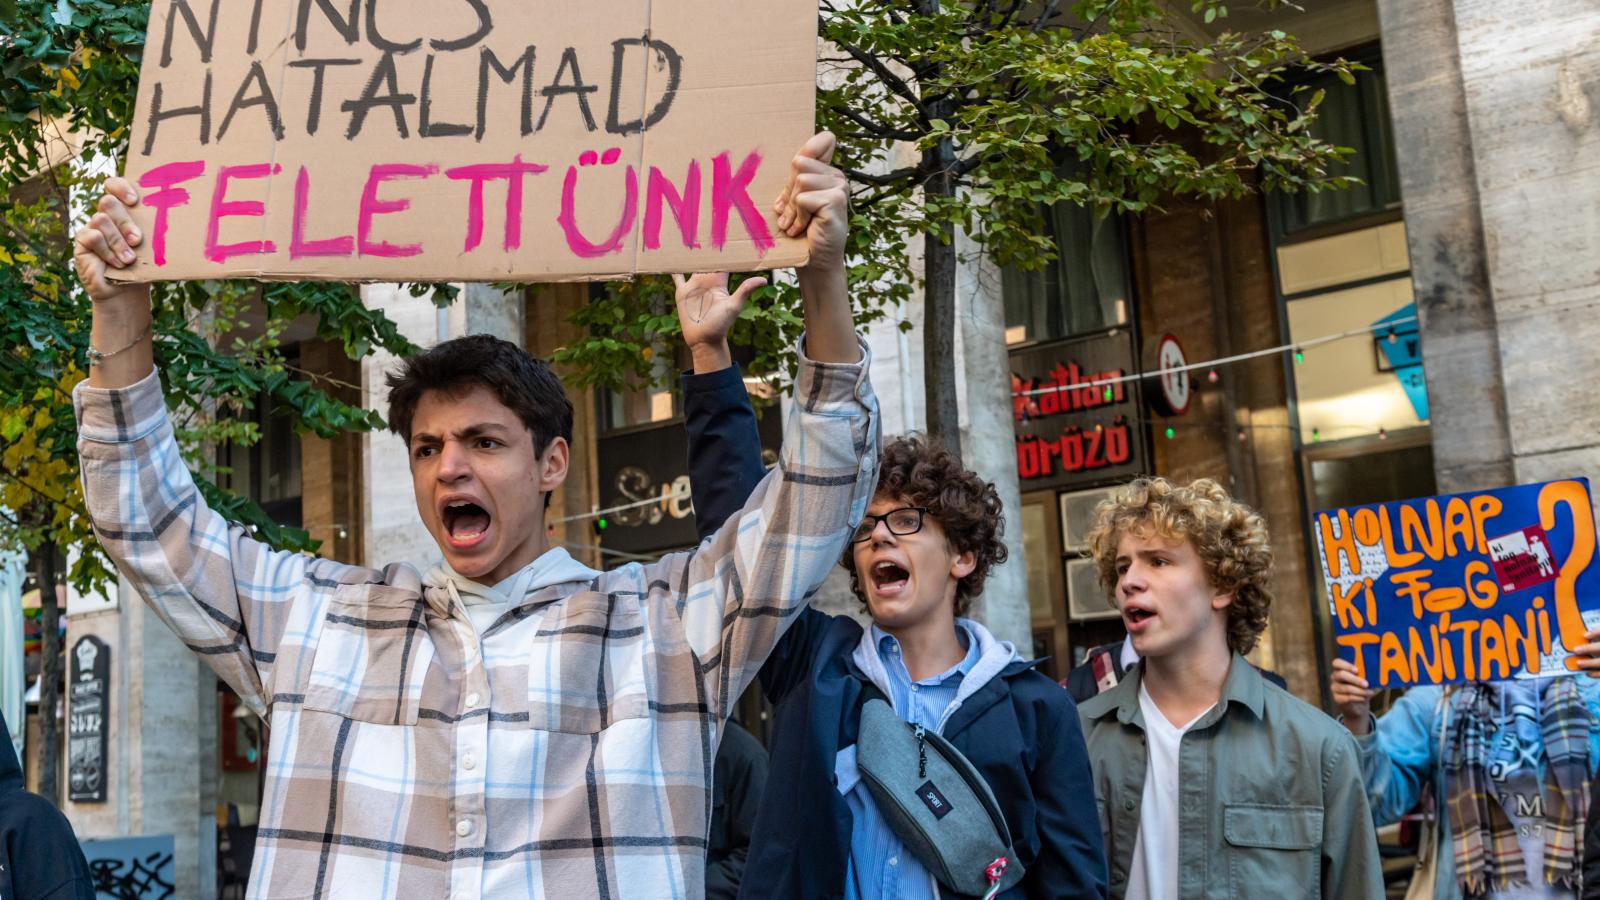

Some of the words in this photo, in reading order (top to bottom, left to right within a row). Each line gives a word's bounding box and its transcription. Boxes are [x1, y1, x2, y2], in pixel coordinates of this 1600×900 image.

[141, 37, 683, 156] HATALMAD
[139, 148, 776, 267] FELETTÜNK
[1319, 494, 1502, 578] HOLNAP
[1390, 560, 1498, 619] FOG
[926, 791, 943, 808] SPORT
